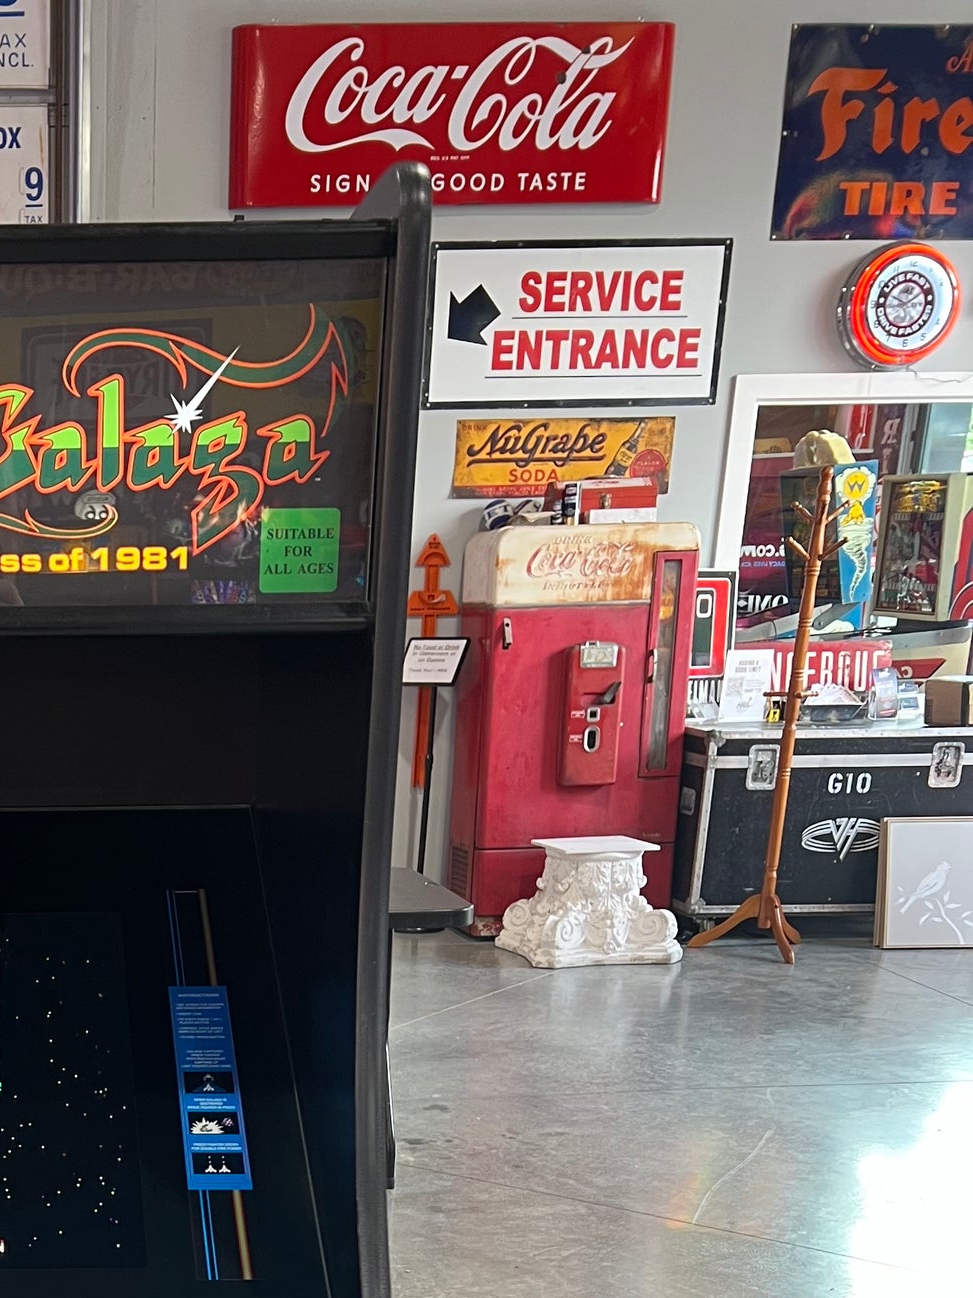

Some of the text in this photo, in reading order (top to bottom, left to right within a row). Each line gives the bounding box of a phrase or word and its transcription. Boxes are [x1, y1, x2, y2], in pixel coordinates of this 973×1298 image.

[285, 36, 635, 153] Coca-Cola
[24, 167, 44, 201] 9
[310, 172, 587, 193] SIGN GOOD TASTE
[839, 181, 960, 216] TIRE
[518, 270, 685, 314] SERVICE
[883, 272, 931, 293] LIVE FAST
[877, 306, 899, 336] DRIVE
[897, 304, 933, 336] FASTER
[491, 328, 702, 371] ENTRANCE
[509, 469, 559, 482] SODA
[266, 527, 336, 540] SUITABLE
[49, 547, 85, 573] of
[91, 545, 189, 571] 1981
[283, 545, 313, 558] FOR
[527, 540, 635, 579] Coca-Cola
[264, 563, 335, 576] ALL AGES
